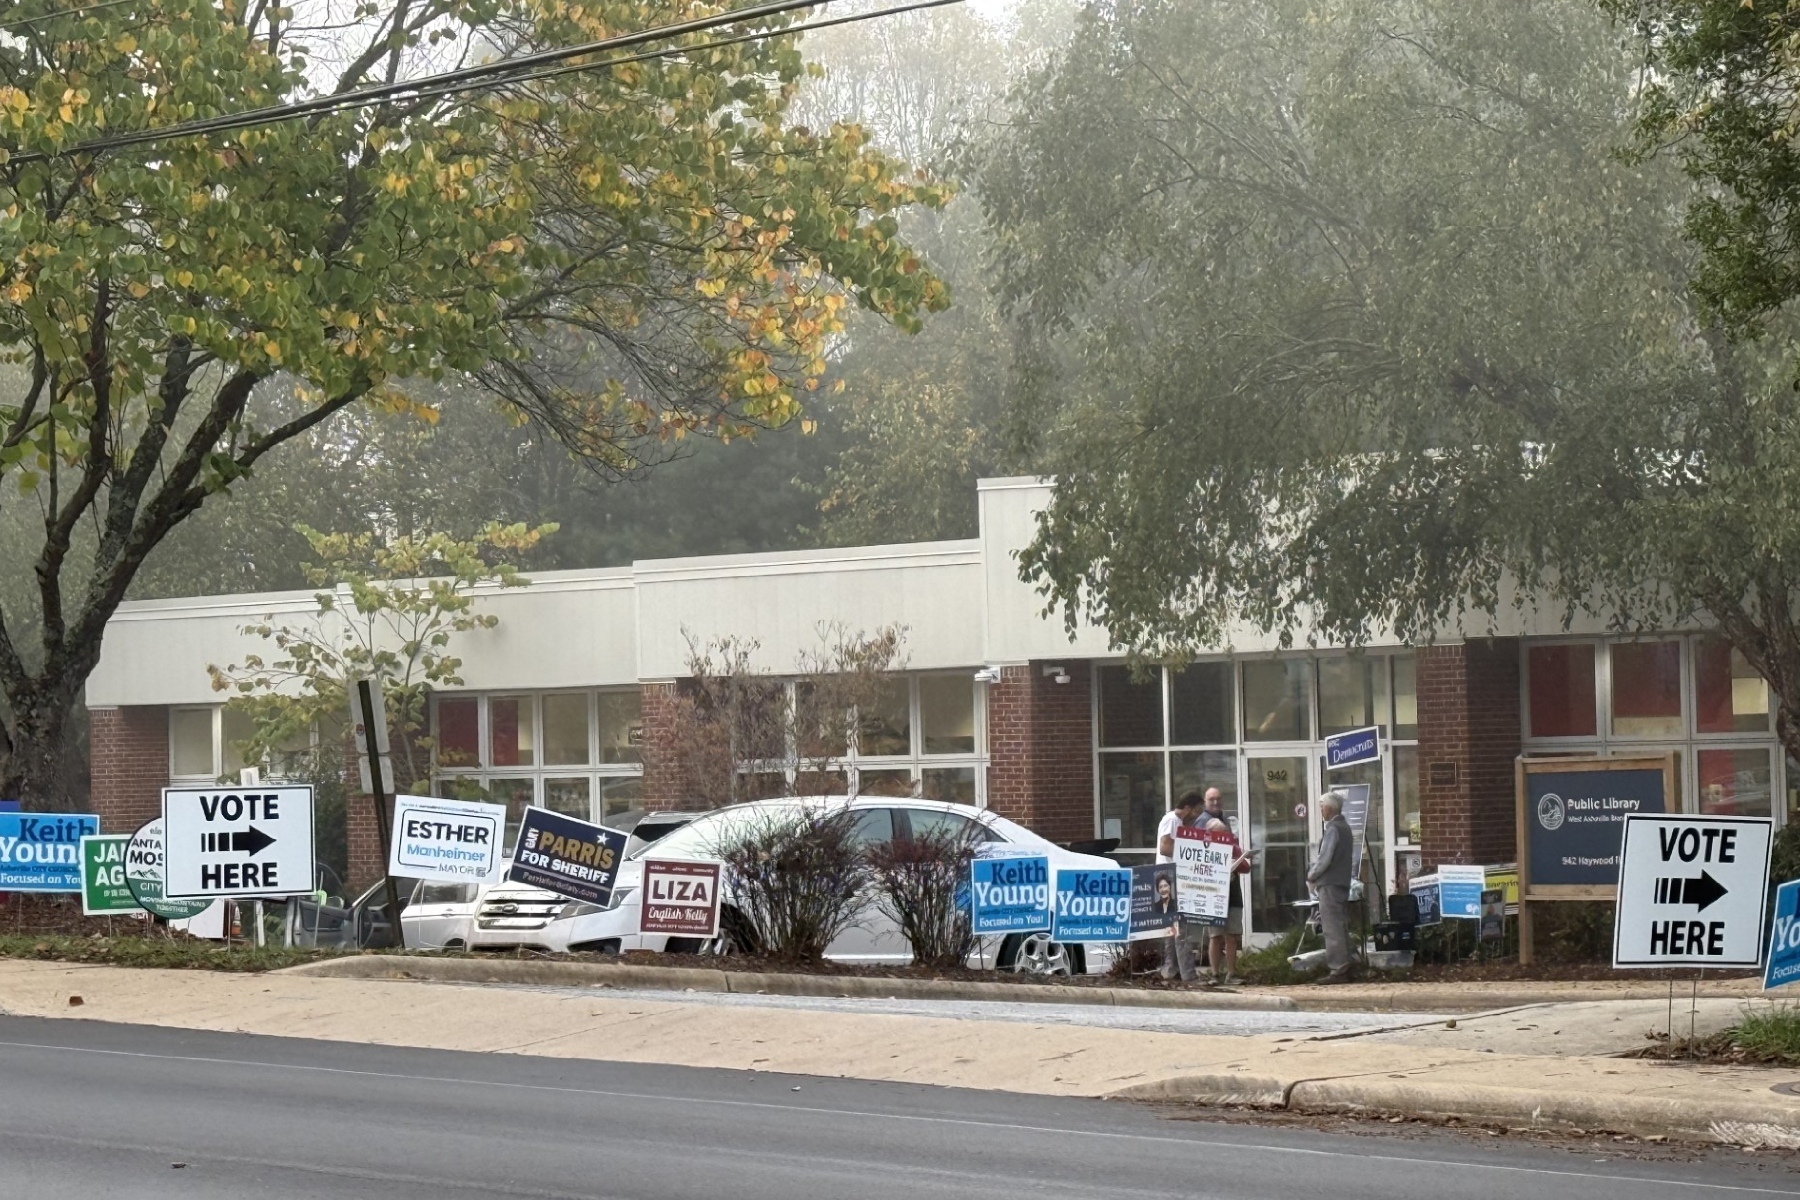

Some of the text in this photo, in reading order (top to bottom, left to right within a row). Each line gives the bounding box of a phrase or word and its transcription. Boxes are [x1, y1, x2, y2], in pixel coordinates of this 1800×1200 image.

[1267, 769, 1287, 780] 942
[200, 795, 279, 821] VOTE
[1567, 798, 1640, 810] Public Library
[19, 818, 95, 842] Keith
[407, 820, 489, 845] ESTHER
[407, 844, 485, 861] Manheimer
[539, 831, 615, 870] PARRIS
[1180, 845, 1229, 867] VOTE EARLY
[1659, 827, 1737, 863] VOTE
[439, 863, 474, 875] MAYOR
[521, 850, 610, 884] FOR SHERIFF
[991, 860, 1046, 885] Keith
[1579, 856, 1613, 866] Haywood
[0, 873, 45, 884] Focused
[48, 876, 61, 884] on
[201, 862, 278, 889] HERE
[1074, 872, 1129, 895] Keith
[652, 880, 708, 902] LIZA
[975, 882, 1048, 910] Young
[648, 906, 708, 925] English Kelly
[1057, 890, 1130, 922] Young
[980, 915, 1012, 927] Focused
[1014, 917, 1024, 925] on
[1650, 921, 1725, 955] HERE
